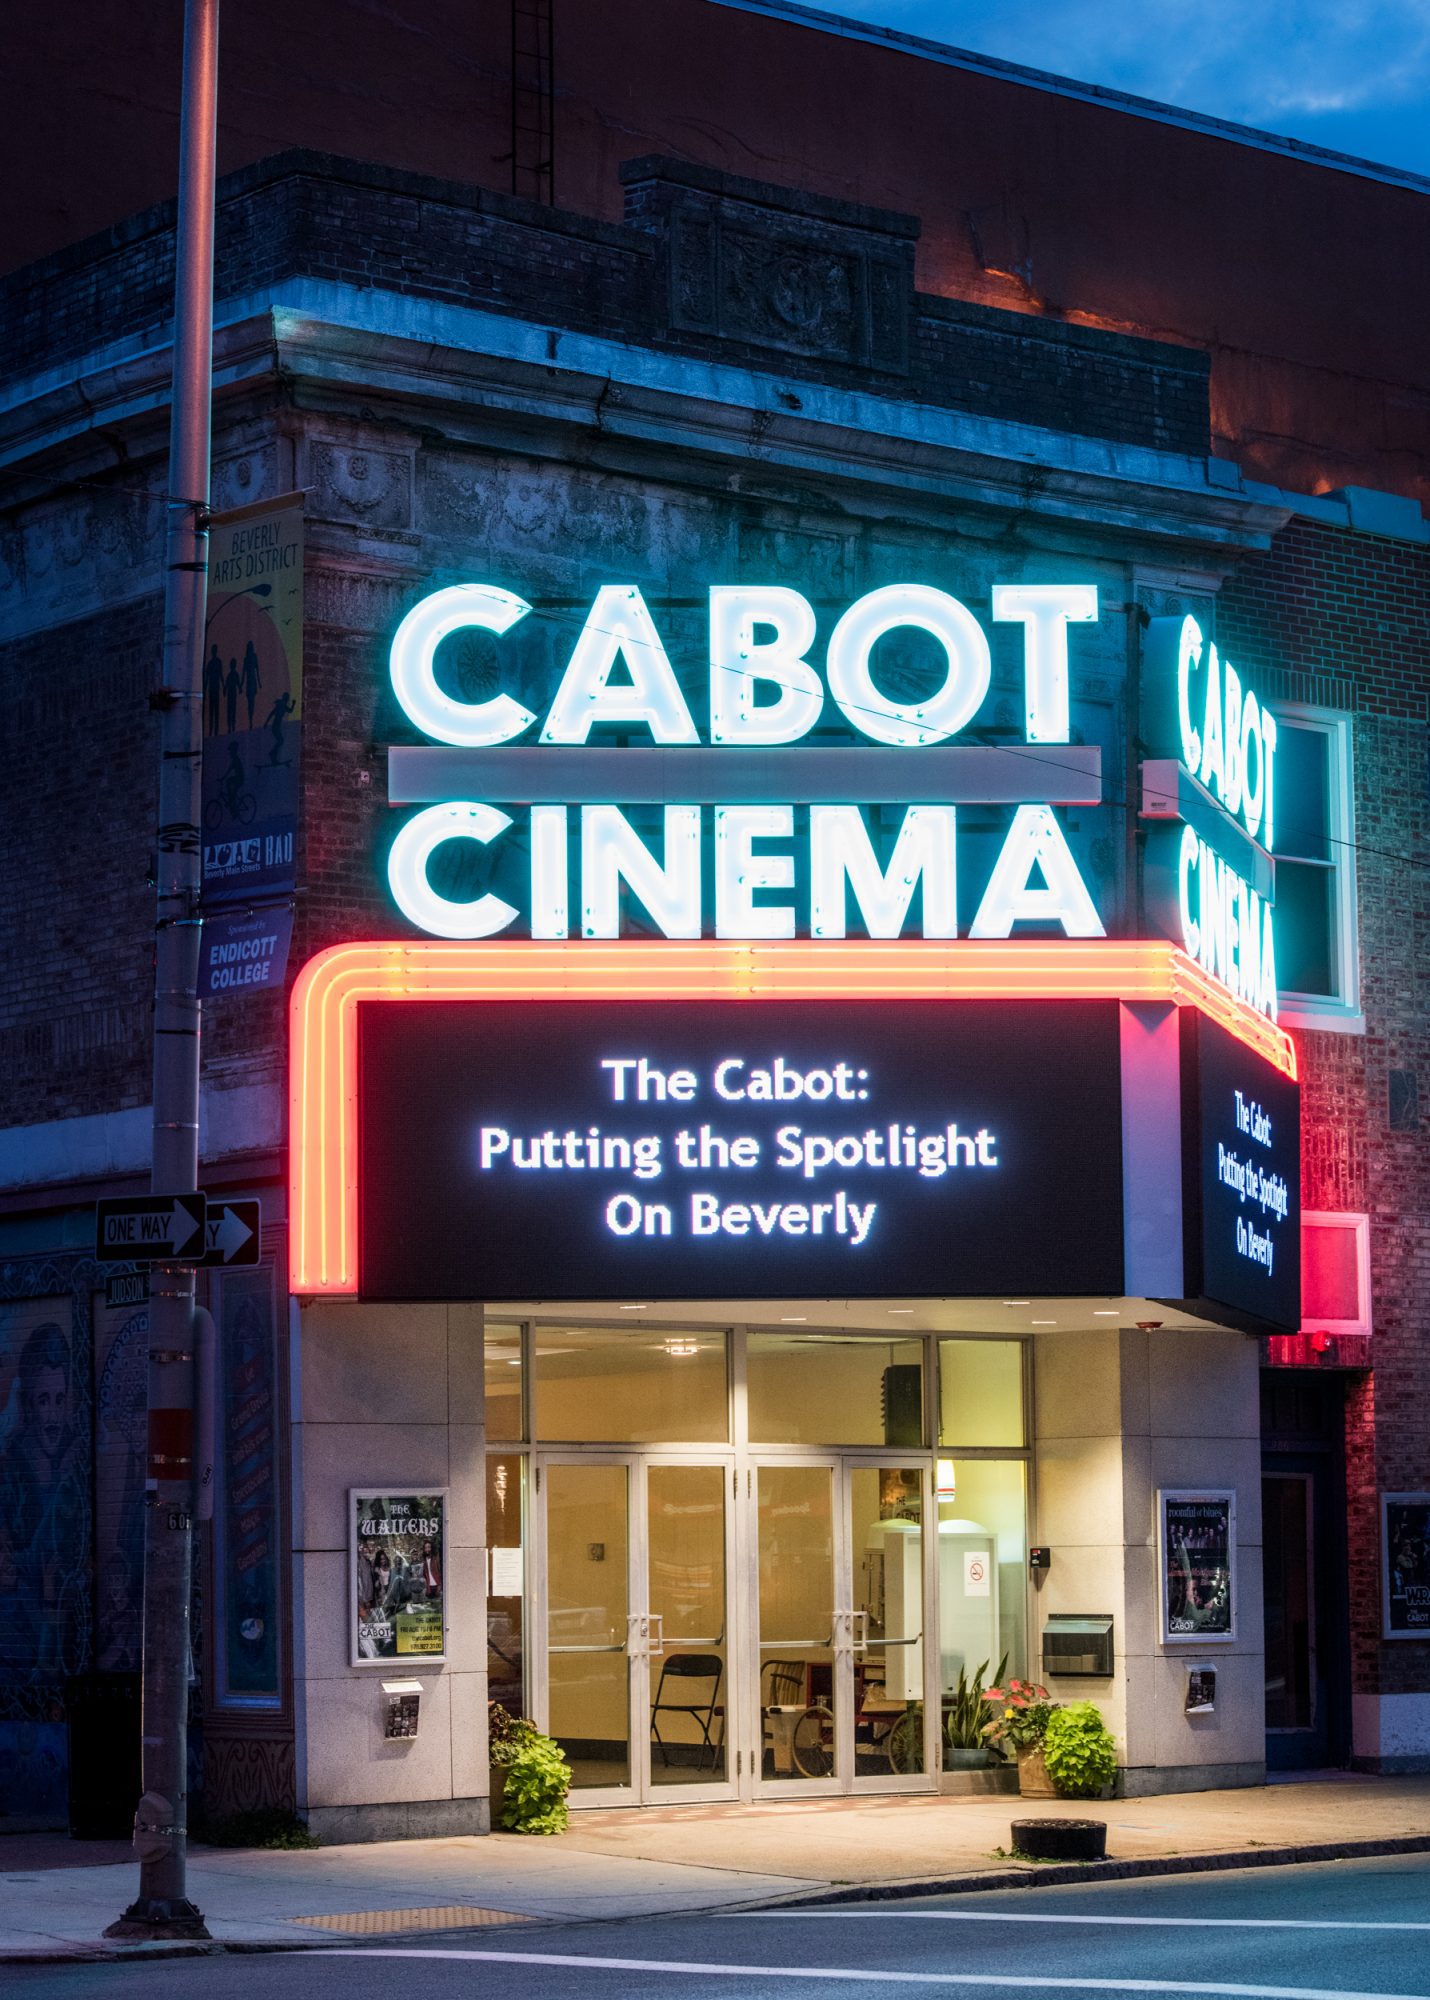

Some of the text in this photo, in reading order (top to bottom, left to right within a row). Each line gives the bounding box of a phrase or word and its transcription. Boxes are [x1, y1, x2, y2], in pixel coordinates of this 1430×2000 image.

[232, 521, 281, 555] BEVERLY
[214, 544, 298, 584] ARTS DISTRICT
[389, 583, 1099, 748] CABOT
[1178, 613, 1278, 854] CABOT
[387, 801, 1108, 940] CINEMA
[1178, 823, 1279, 1025] CINEMA
[210, 935, 278, 966] ENDICOTT
[211, 961, 271, 990] COLLEGE
[602, 1057, 869, 1101] The Cabot:
[1234, 1090, 1271, 1148] The Cabot:
[481, 1123, 998, 1179] Putting the Spotlight
[1219, 1142, 1288, 1222] Putting the Spotlight
[108, 1215, 171, 1242] ONE WAY
[606, 1191, 877, 1245] On Beverly
[1237, 1216, 1273, 1277] On Beverly
[109, 1275, 143, 1302] JUDSON
[361, 1517, 439, 1537] WAILERS
[360, 1628, 390, 1638] CABOT
[1170, 1621, 1194, 1630] CABOT
